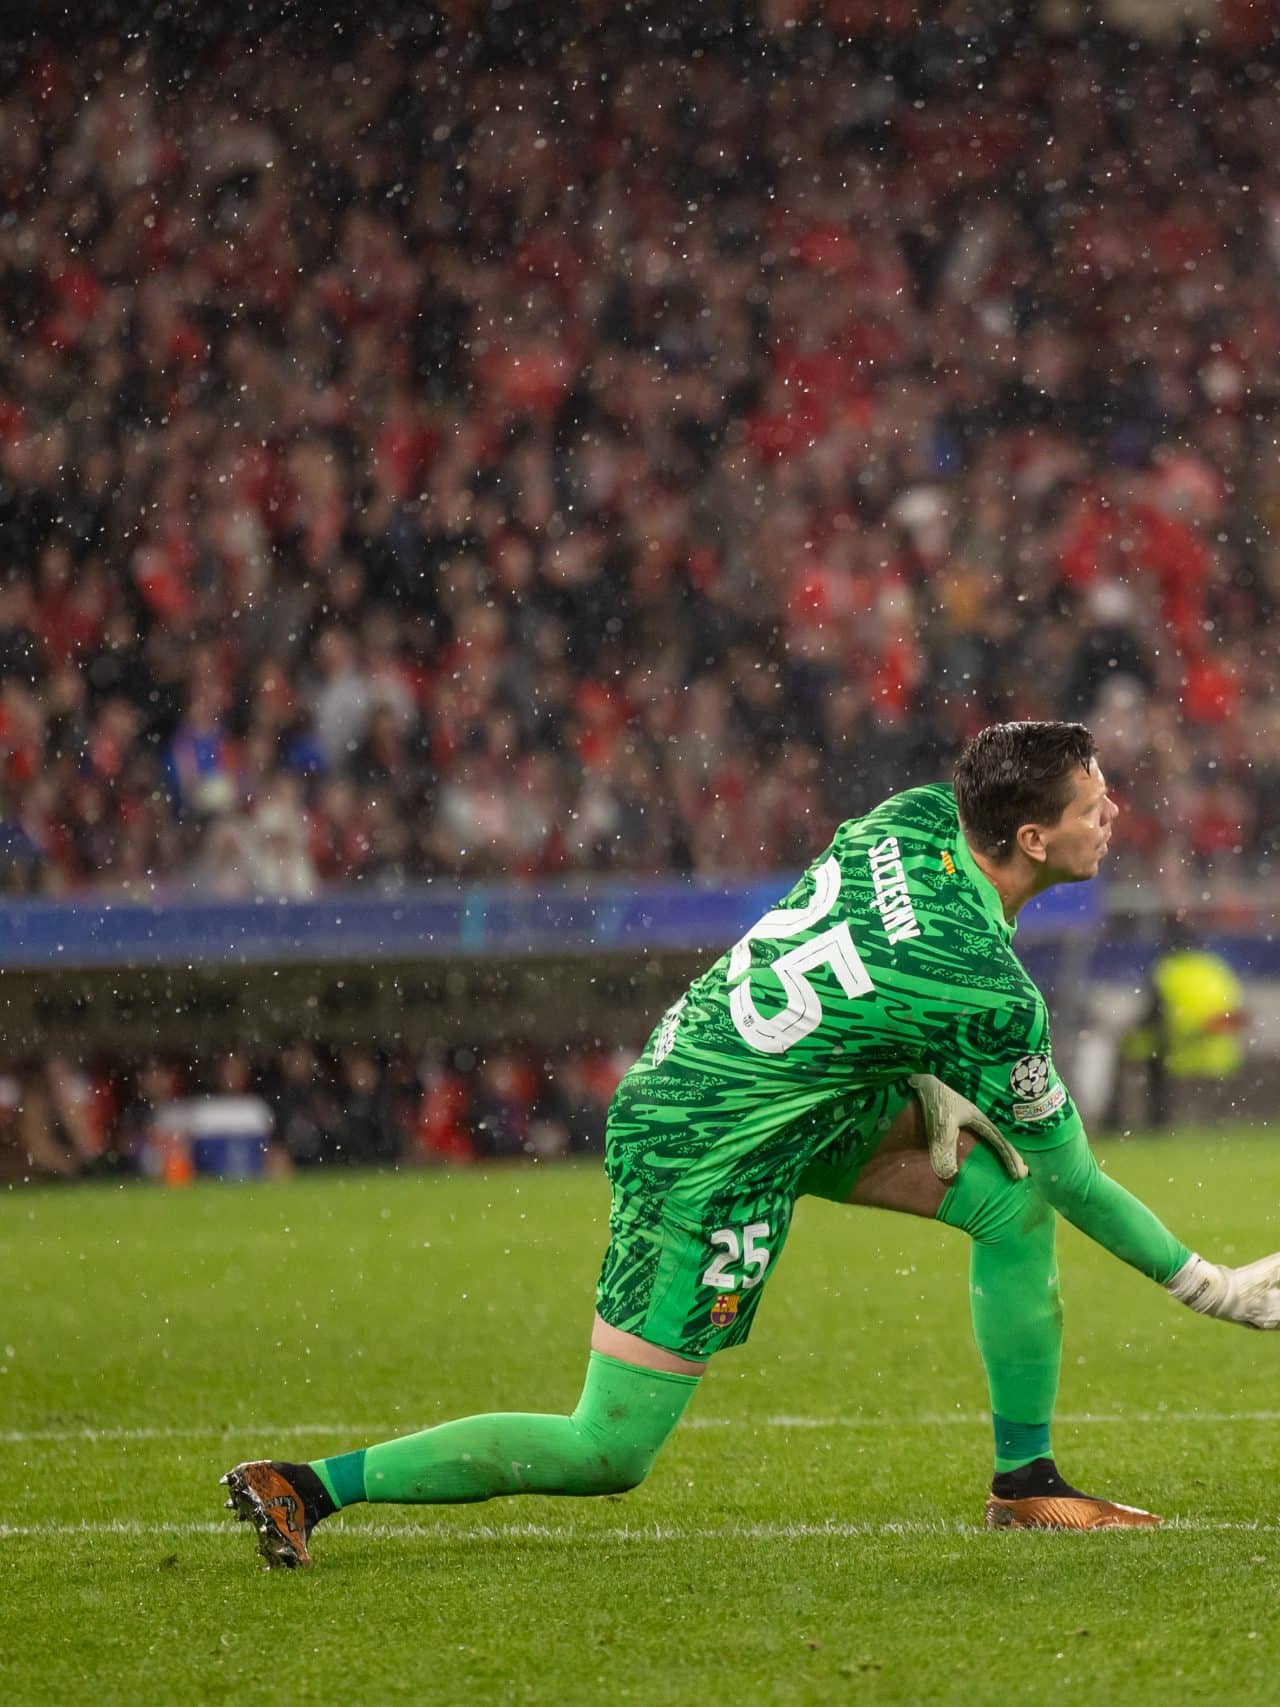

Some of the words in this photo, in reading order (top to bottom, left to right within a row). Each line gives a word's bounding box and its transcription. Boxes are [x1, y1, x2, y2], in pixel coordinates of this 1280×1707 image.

[727, 854, 876, 1054] 25
[1028, 1067, 1041, 1086] 5
[702, 1223, 770, 1289] 25
